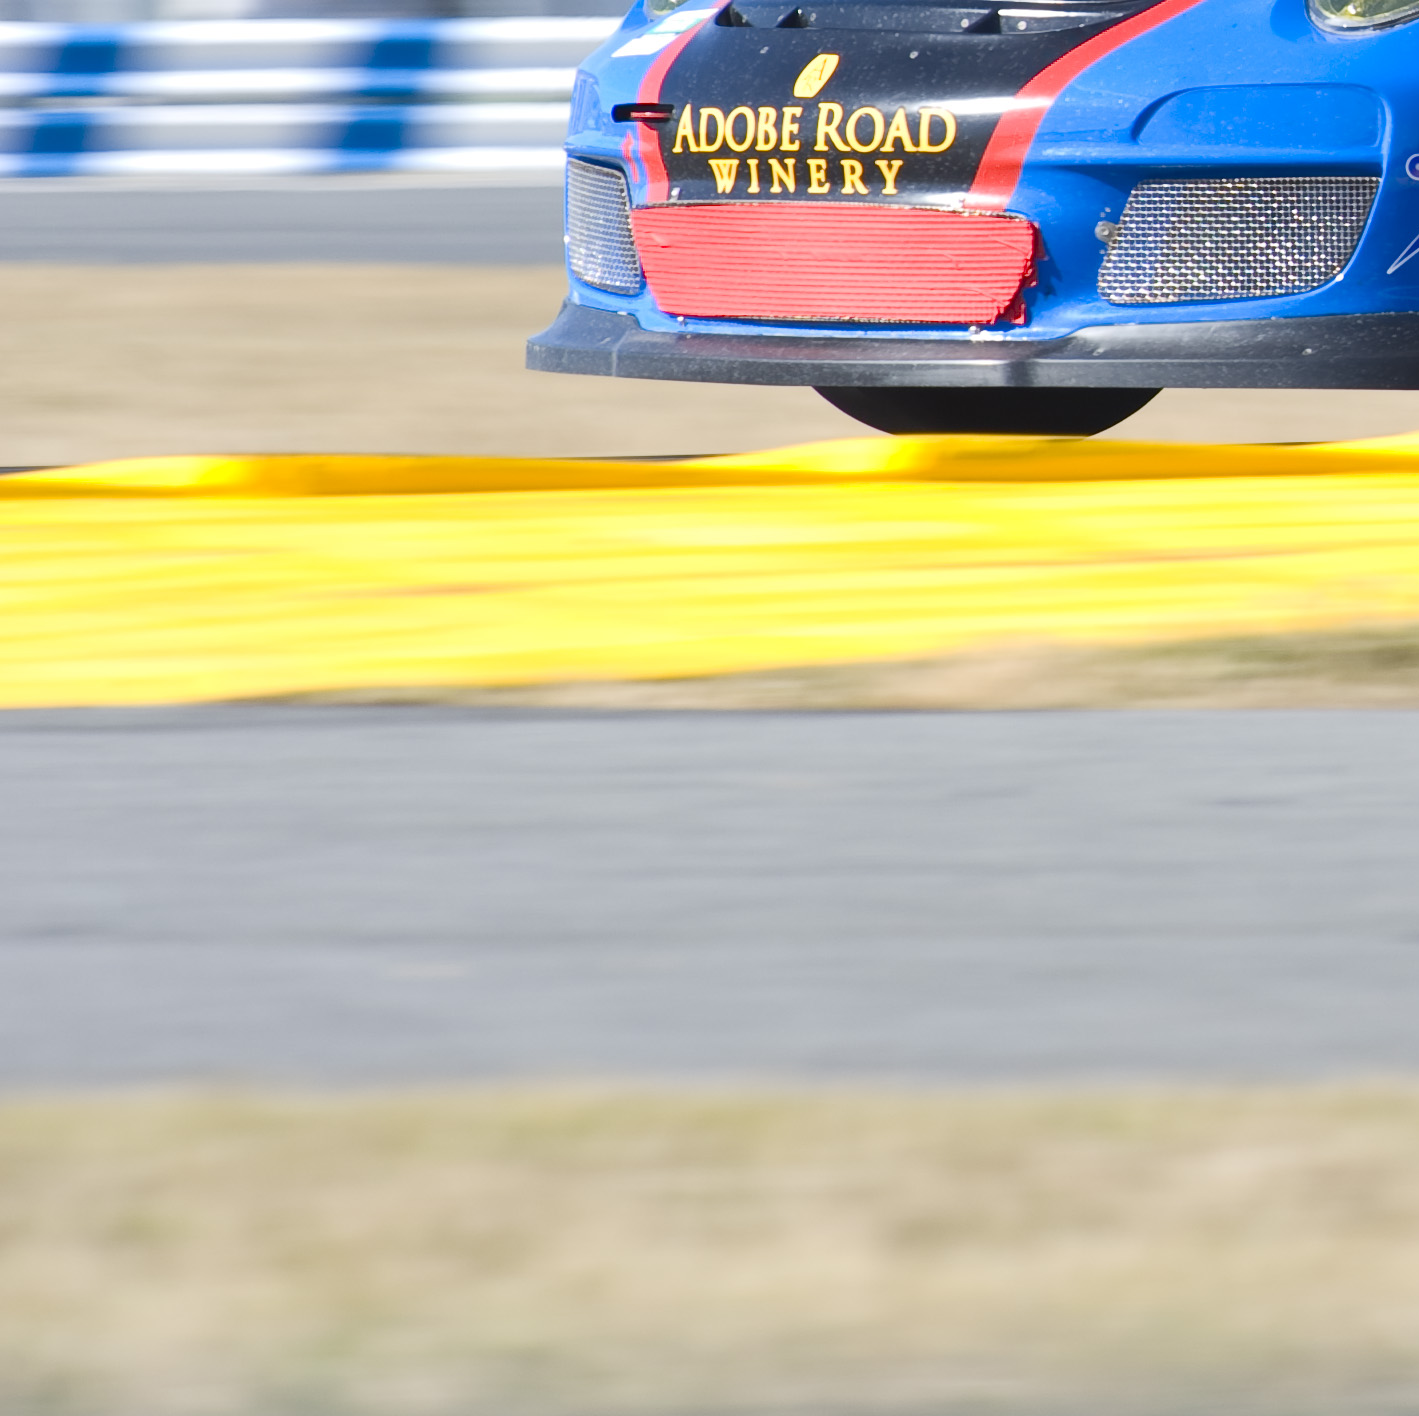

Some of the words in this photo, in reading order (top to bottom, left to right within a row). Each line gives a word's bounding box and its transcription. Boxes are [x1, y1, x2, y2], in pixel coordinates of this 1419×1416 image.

[671, 102, 804, 154] ADOBE
[813, 101, 958, 154] ROAD
[707, 158, 904, 196] WINERY
